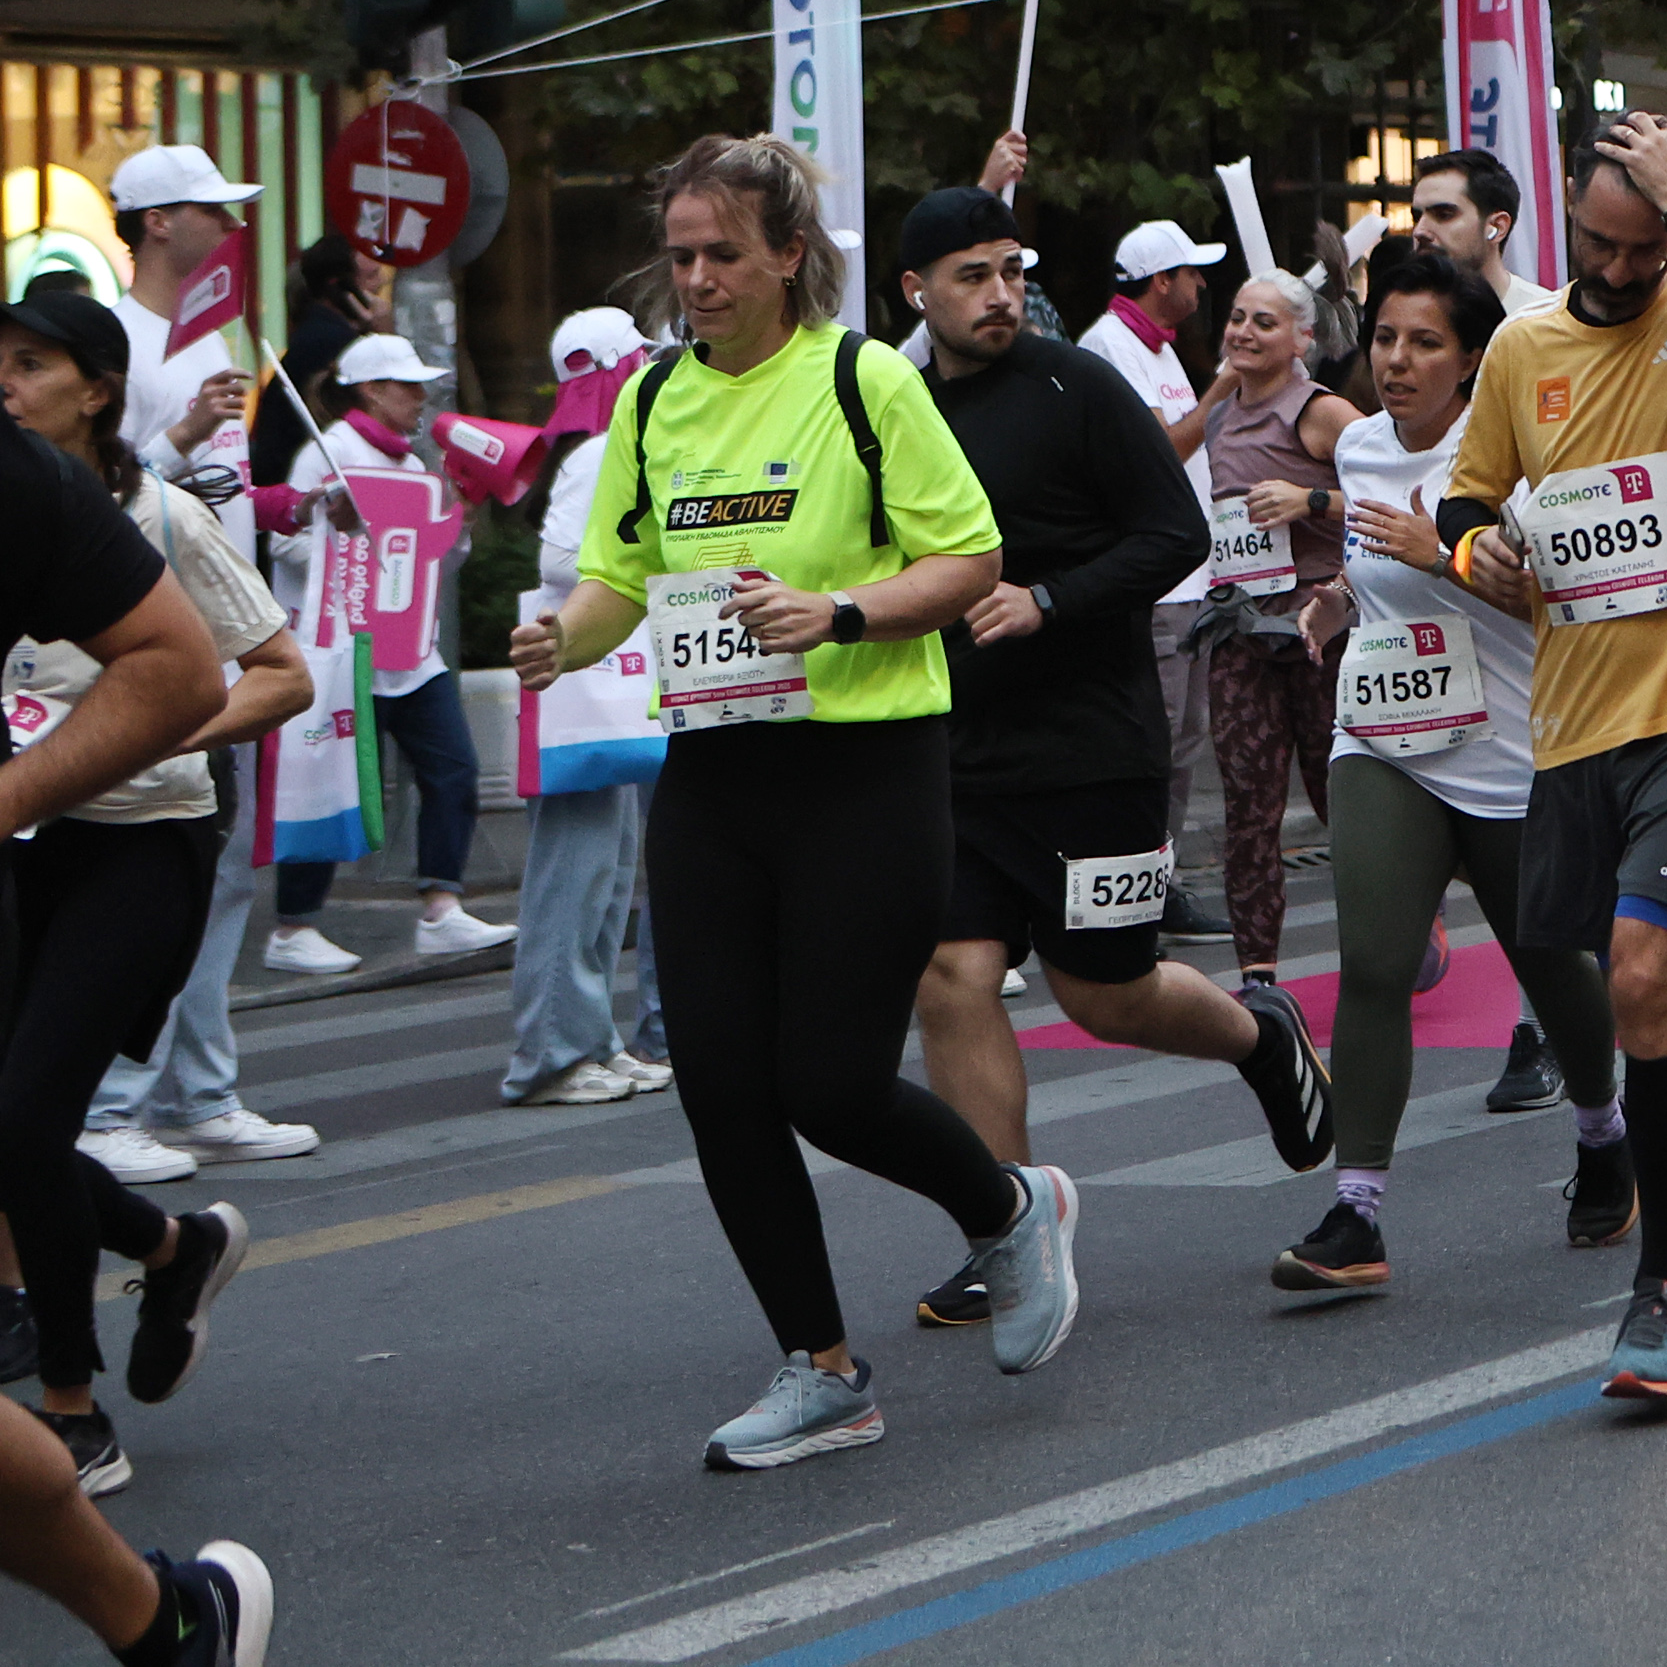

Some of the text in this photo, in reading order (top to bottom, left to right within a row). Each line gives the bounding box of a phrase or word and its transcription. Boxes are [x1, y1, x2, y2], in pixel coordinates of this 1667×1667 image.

[670, 493, 792, 526] #BEACTIVE
[1539, 483, 1612, 509] COSMOTE
[354, 533, 370, 563] σο
[1215, 530, 1274, 563] 51464
[1550, 513, 1663, 567] 50893
[667, 587, 736, 607] COSMOTE
[673, 627, 775, 669] 5154
[1359, 637, 1408, 653] COSMOTE
[1356, 665, 1452, 705] 51587
[1073, 878, 1081, 905] BLOCK
